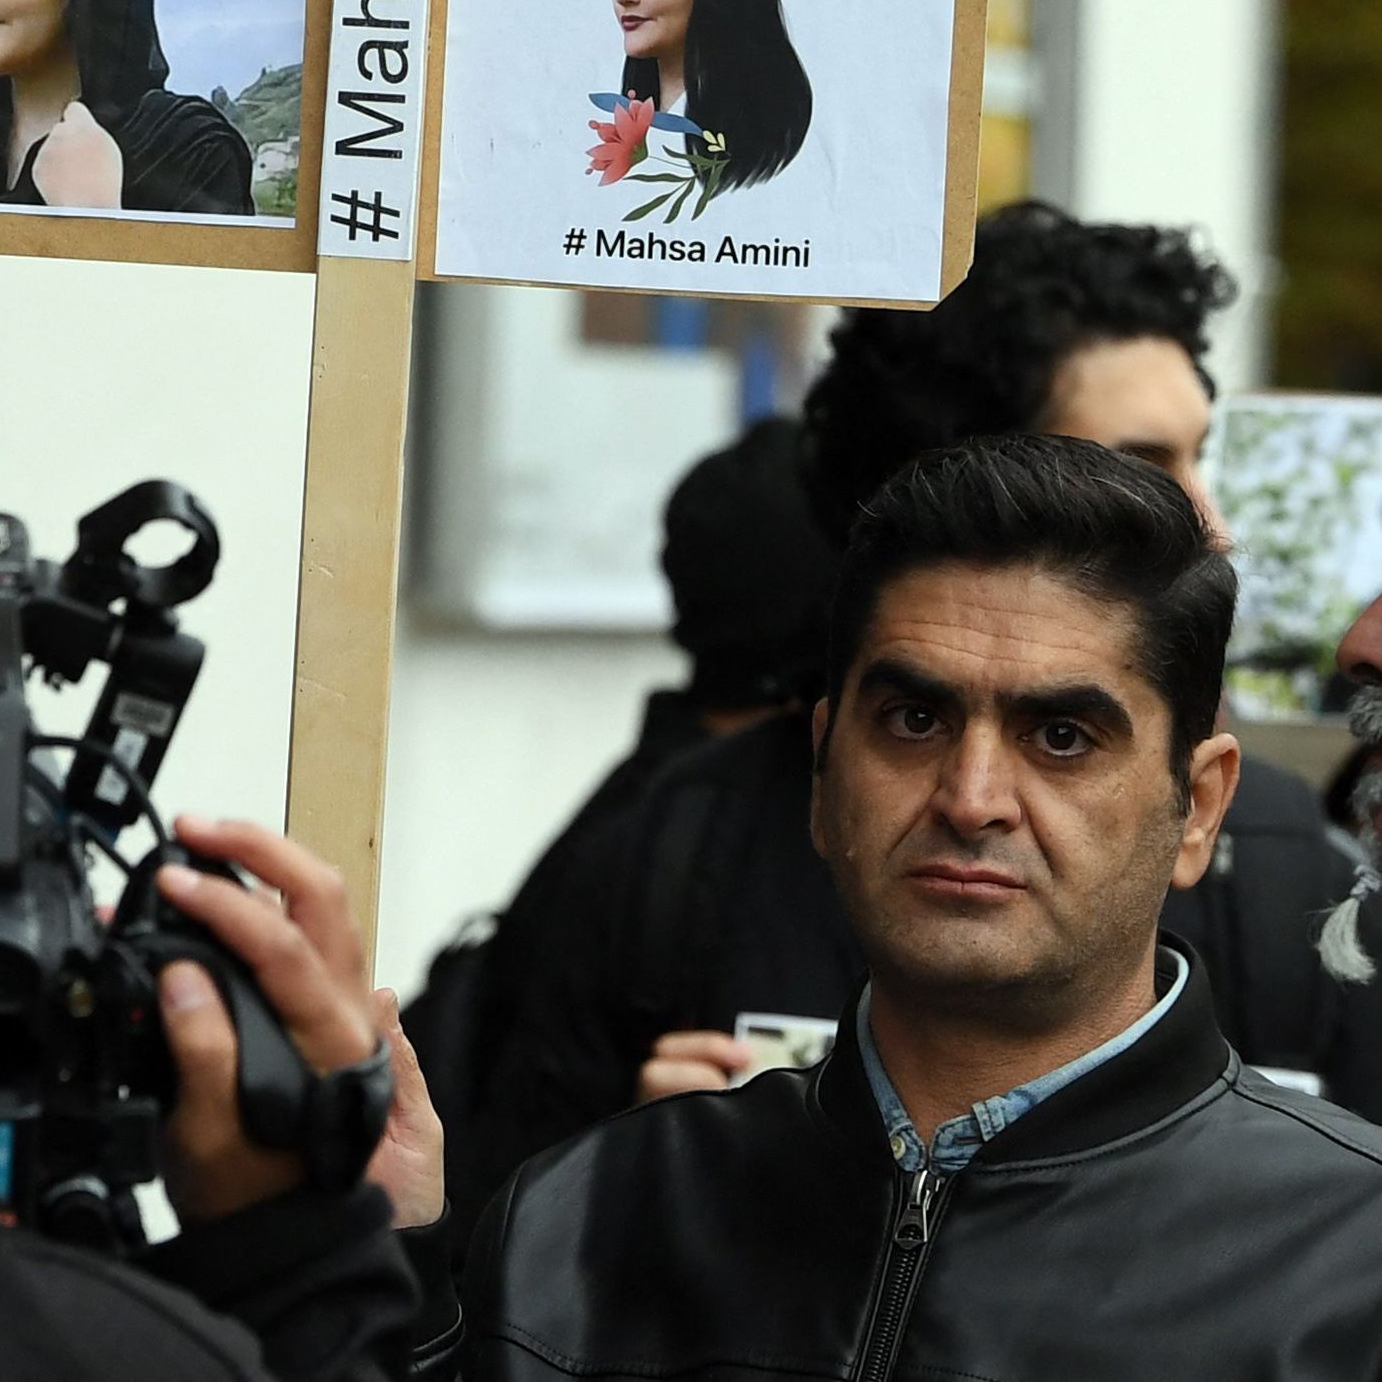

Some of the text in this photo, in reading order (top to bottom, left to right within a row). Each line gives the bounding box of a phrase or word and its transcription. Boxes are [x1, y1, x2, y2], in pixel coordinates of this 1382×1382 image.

[330, 189, 400, 241] #
[563, 228, 810, 268] # Mahsa Amini
